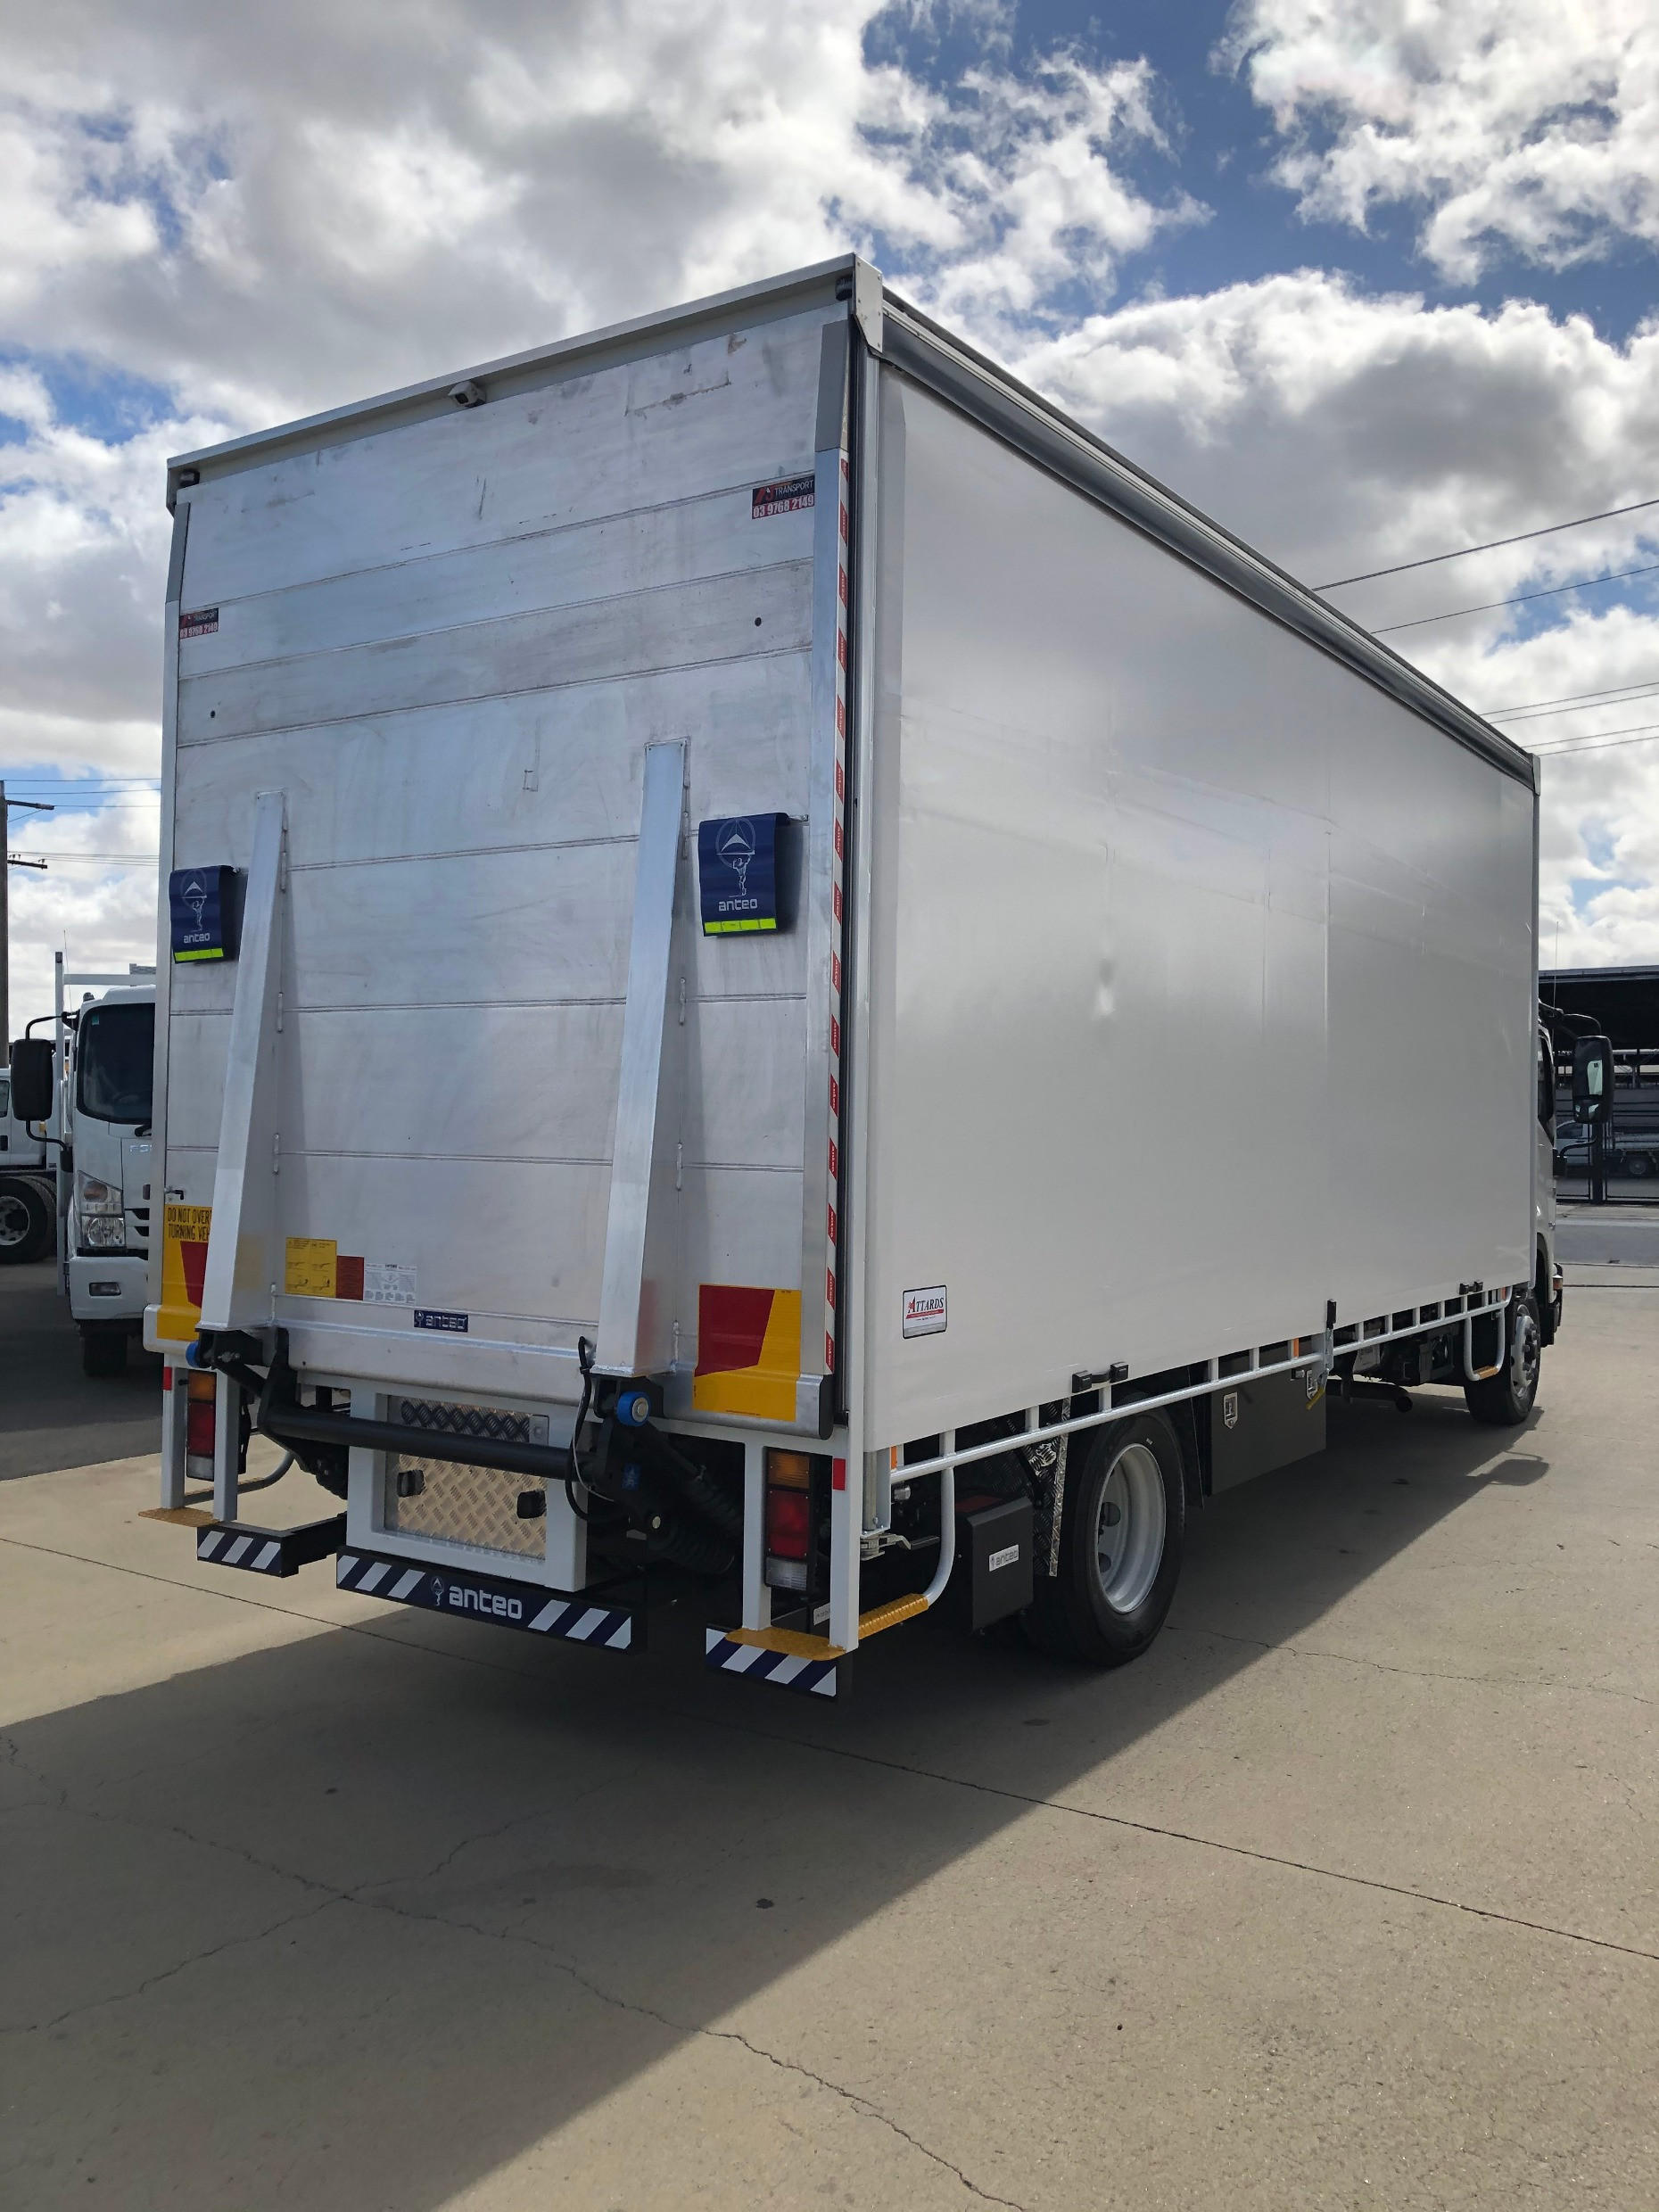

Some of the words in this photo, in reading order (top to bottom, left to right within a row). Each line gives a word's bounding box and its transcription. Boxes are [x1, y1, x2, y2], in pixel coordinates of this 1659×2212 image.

[775, 479, 813, 496] TRANSPORT
[753, 505, 765, 518] 03
[767, 499, 790, 516] 9768
[791, 493, 813, 510] 2149
[718, 898, 758, 912] anteo
[183, 932, 210, 944] anteo
[168, 1207, 177, 1222] DO
[178, 1208, 190, 1223] NOT
[169, 1223, 195, 1240] TURNING
[907, 1296, 945, 1314] ATTARDS
[425, 1315, 466, 1329] anteo
[995, 1550, 1019, 1566] anteo
[449, 1585, 523, 1620] anteo
